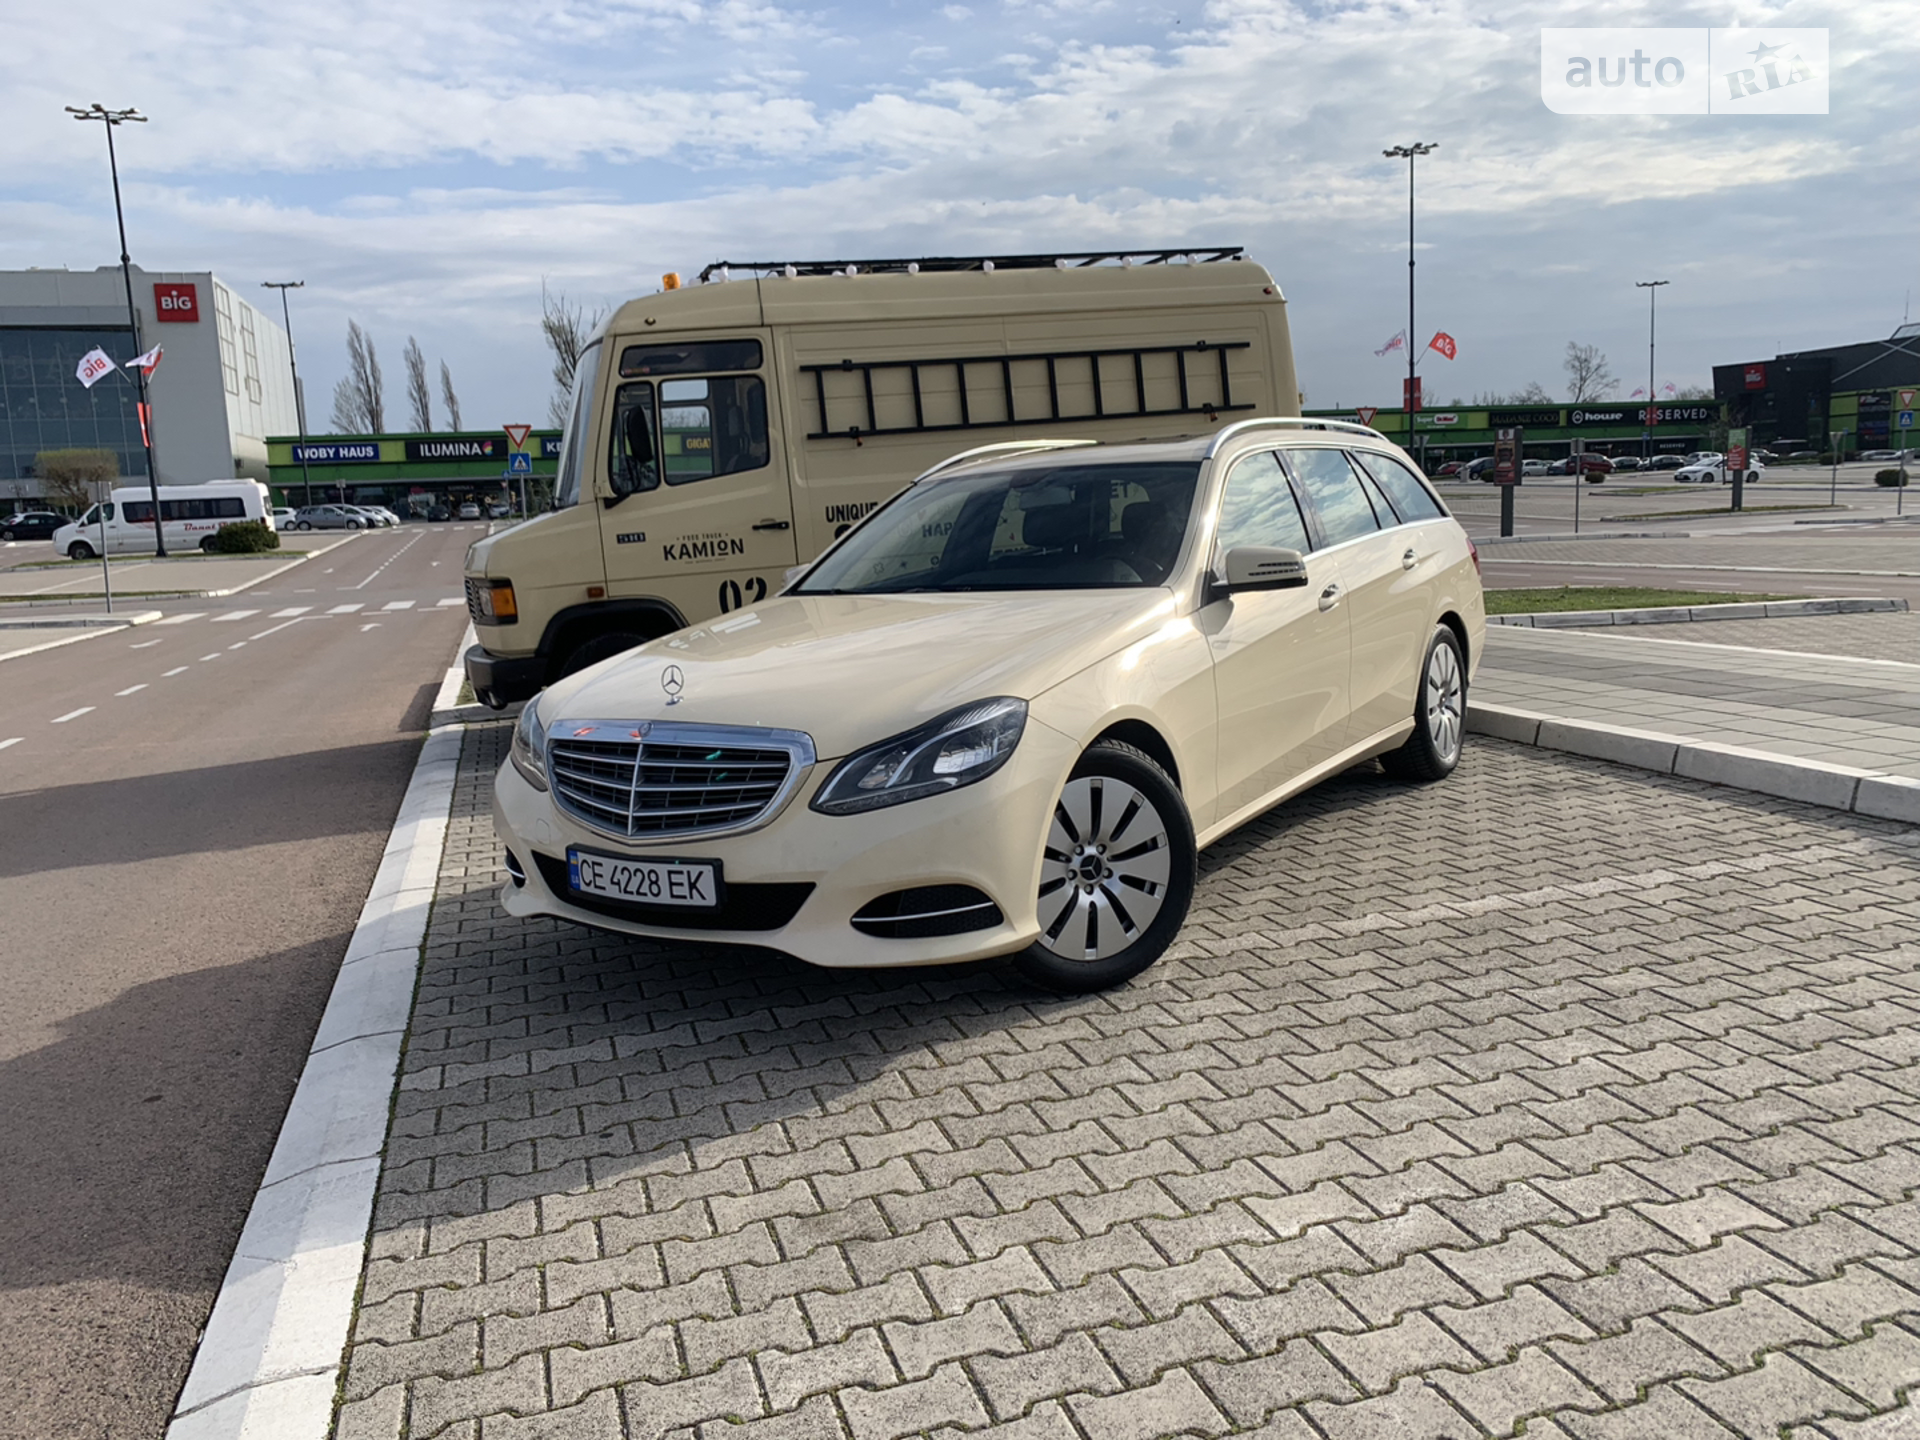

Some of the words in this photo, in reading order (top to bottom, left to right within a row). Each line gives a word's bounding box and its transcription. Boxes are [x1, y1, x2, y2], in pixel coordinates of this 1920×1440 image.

[1638, 408, 1708, 420] RSERVED
[297, 447, 336, 459] WOBY
[338, 446, 374, 458] HAUS
[420, 442, 482, 457] ILUMINA
[663, 538, 744, 561] KAMION
[719, 577, 767, 614] 02
[580, 859, 606, 890] CE
[610, 865, 661, 897] 4228
[667, 869, 707, 900] EK
